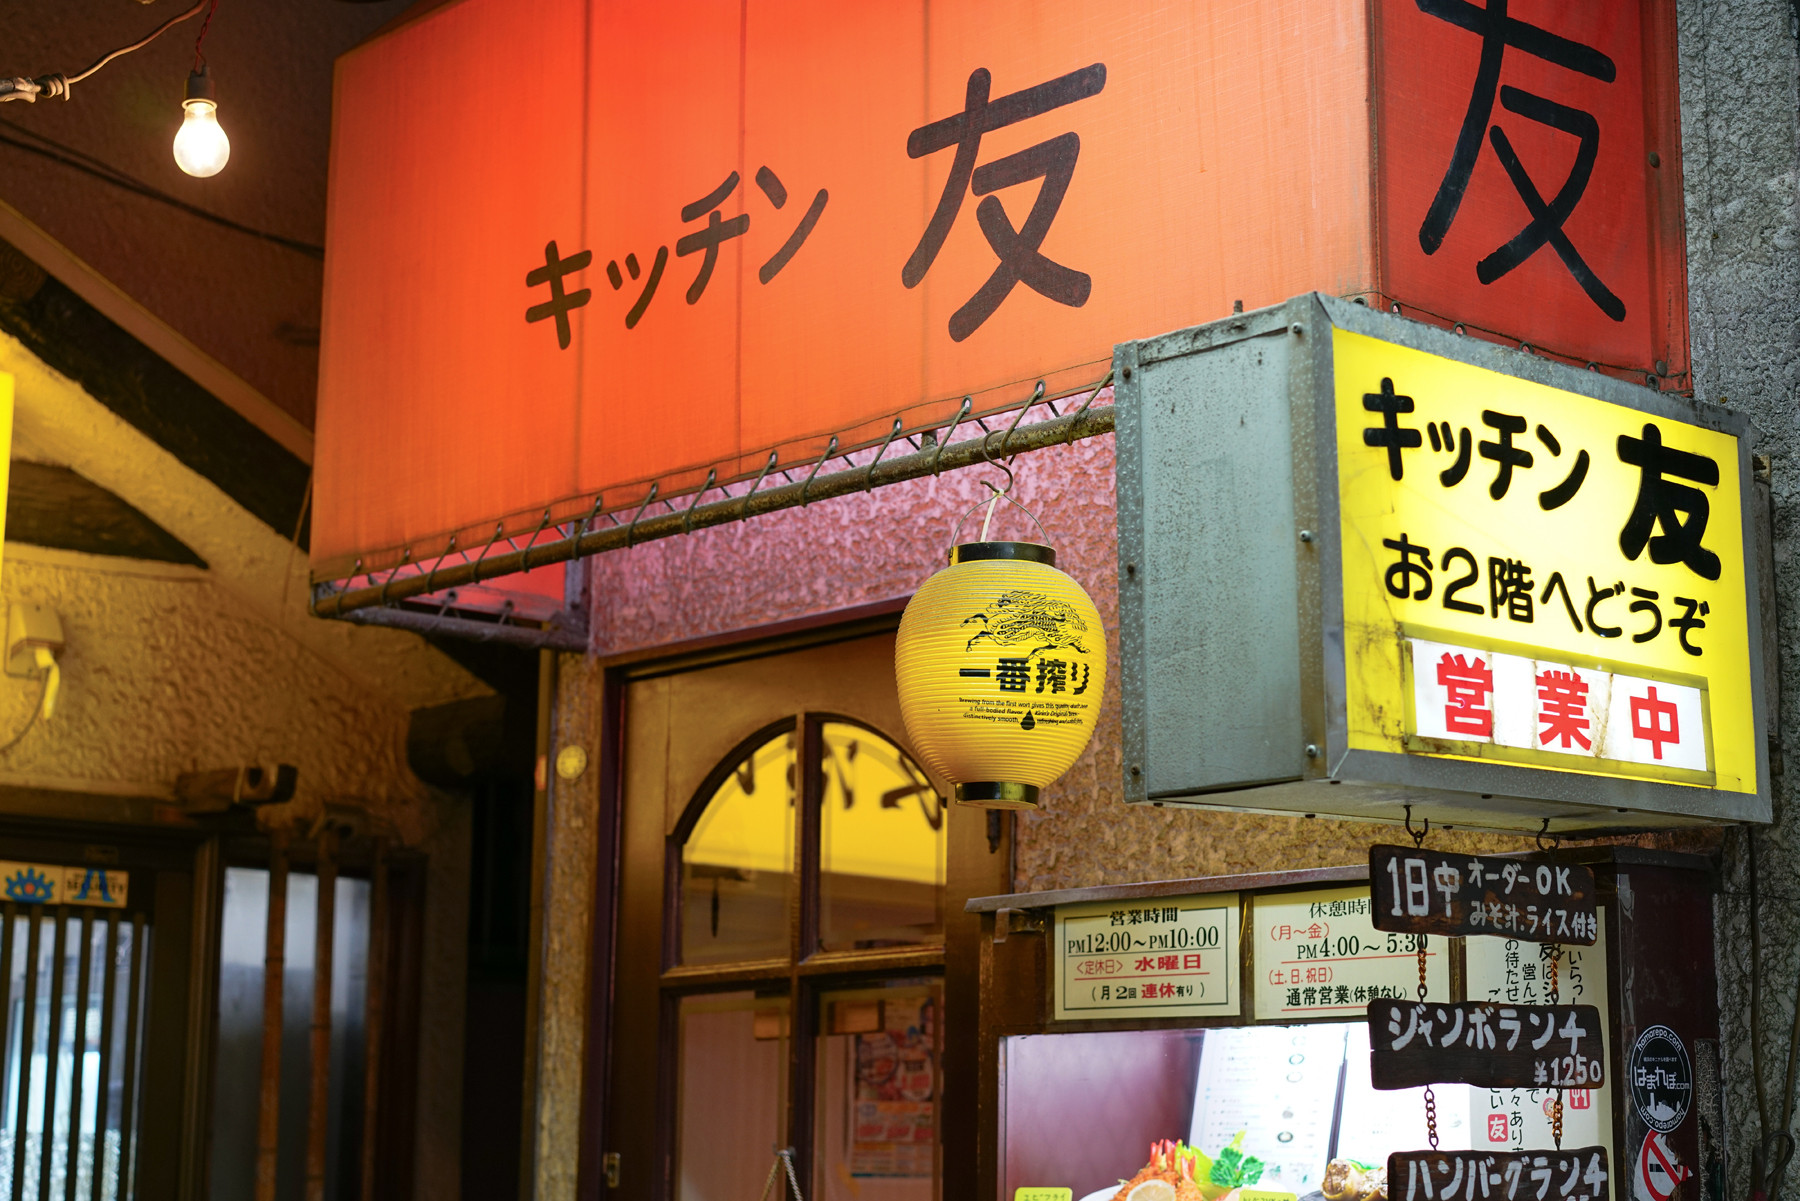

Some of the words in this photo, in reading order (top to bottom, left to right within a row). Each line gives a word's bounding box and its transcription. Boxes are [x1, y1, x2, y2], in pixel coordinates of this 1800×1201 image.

[1415, 0, 1626, 322] 友
[525, 165, 829, 350] キッチン
[902, 63, 1107, 342] 友
[1362, 377, 1590, 511] キッチン
[1616, 422, 1722, 581] 友
[1383, 533, 1711, 656] お2階へどうぞ
[959, 658, 1090, 695] 一番搾り
[963, 712, 997, 722] distinctively
[1006, 700, 1017, 708] first
[1437, 652, 1680, 760] 営業中
[1387, 857, 1460, 917] 1日中
[1110, 907, 1178, 926] 営業時間
[1308, 899, 1372, 918] 休憩時
[1135, 954, 1201, 972] 水曜日
[1505, 939, 1519, 1004] 待たせ
[1388, 1003, 1587, 1055] ジャンボランチ
[1637, 1027, 1682, 1051] hamarepo.com
[1489, 1088, 1504, 1110] い
[1634, 1066, 1690, 1090] はまれぽ.com
[1490, 1117, 1506, 1140] 友
[1510, 1088, 1523, 1151] 々あり
[1406, 1153, 1608, 1201] ハンバーグランチ
